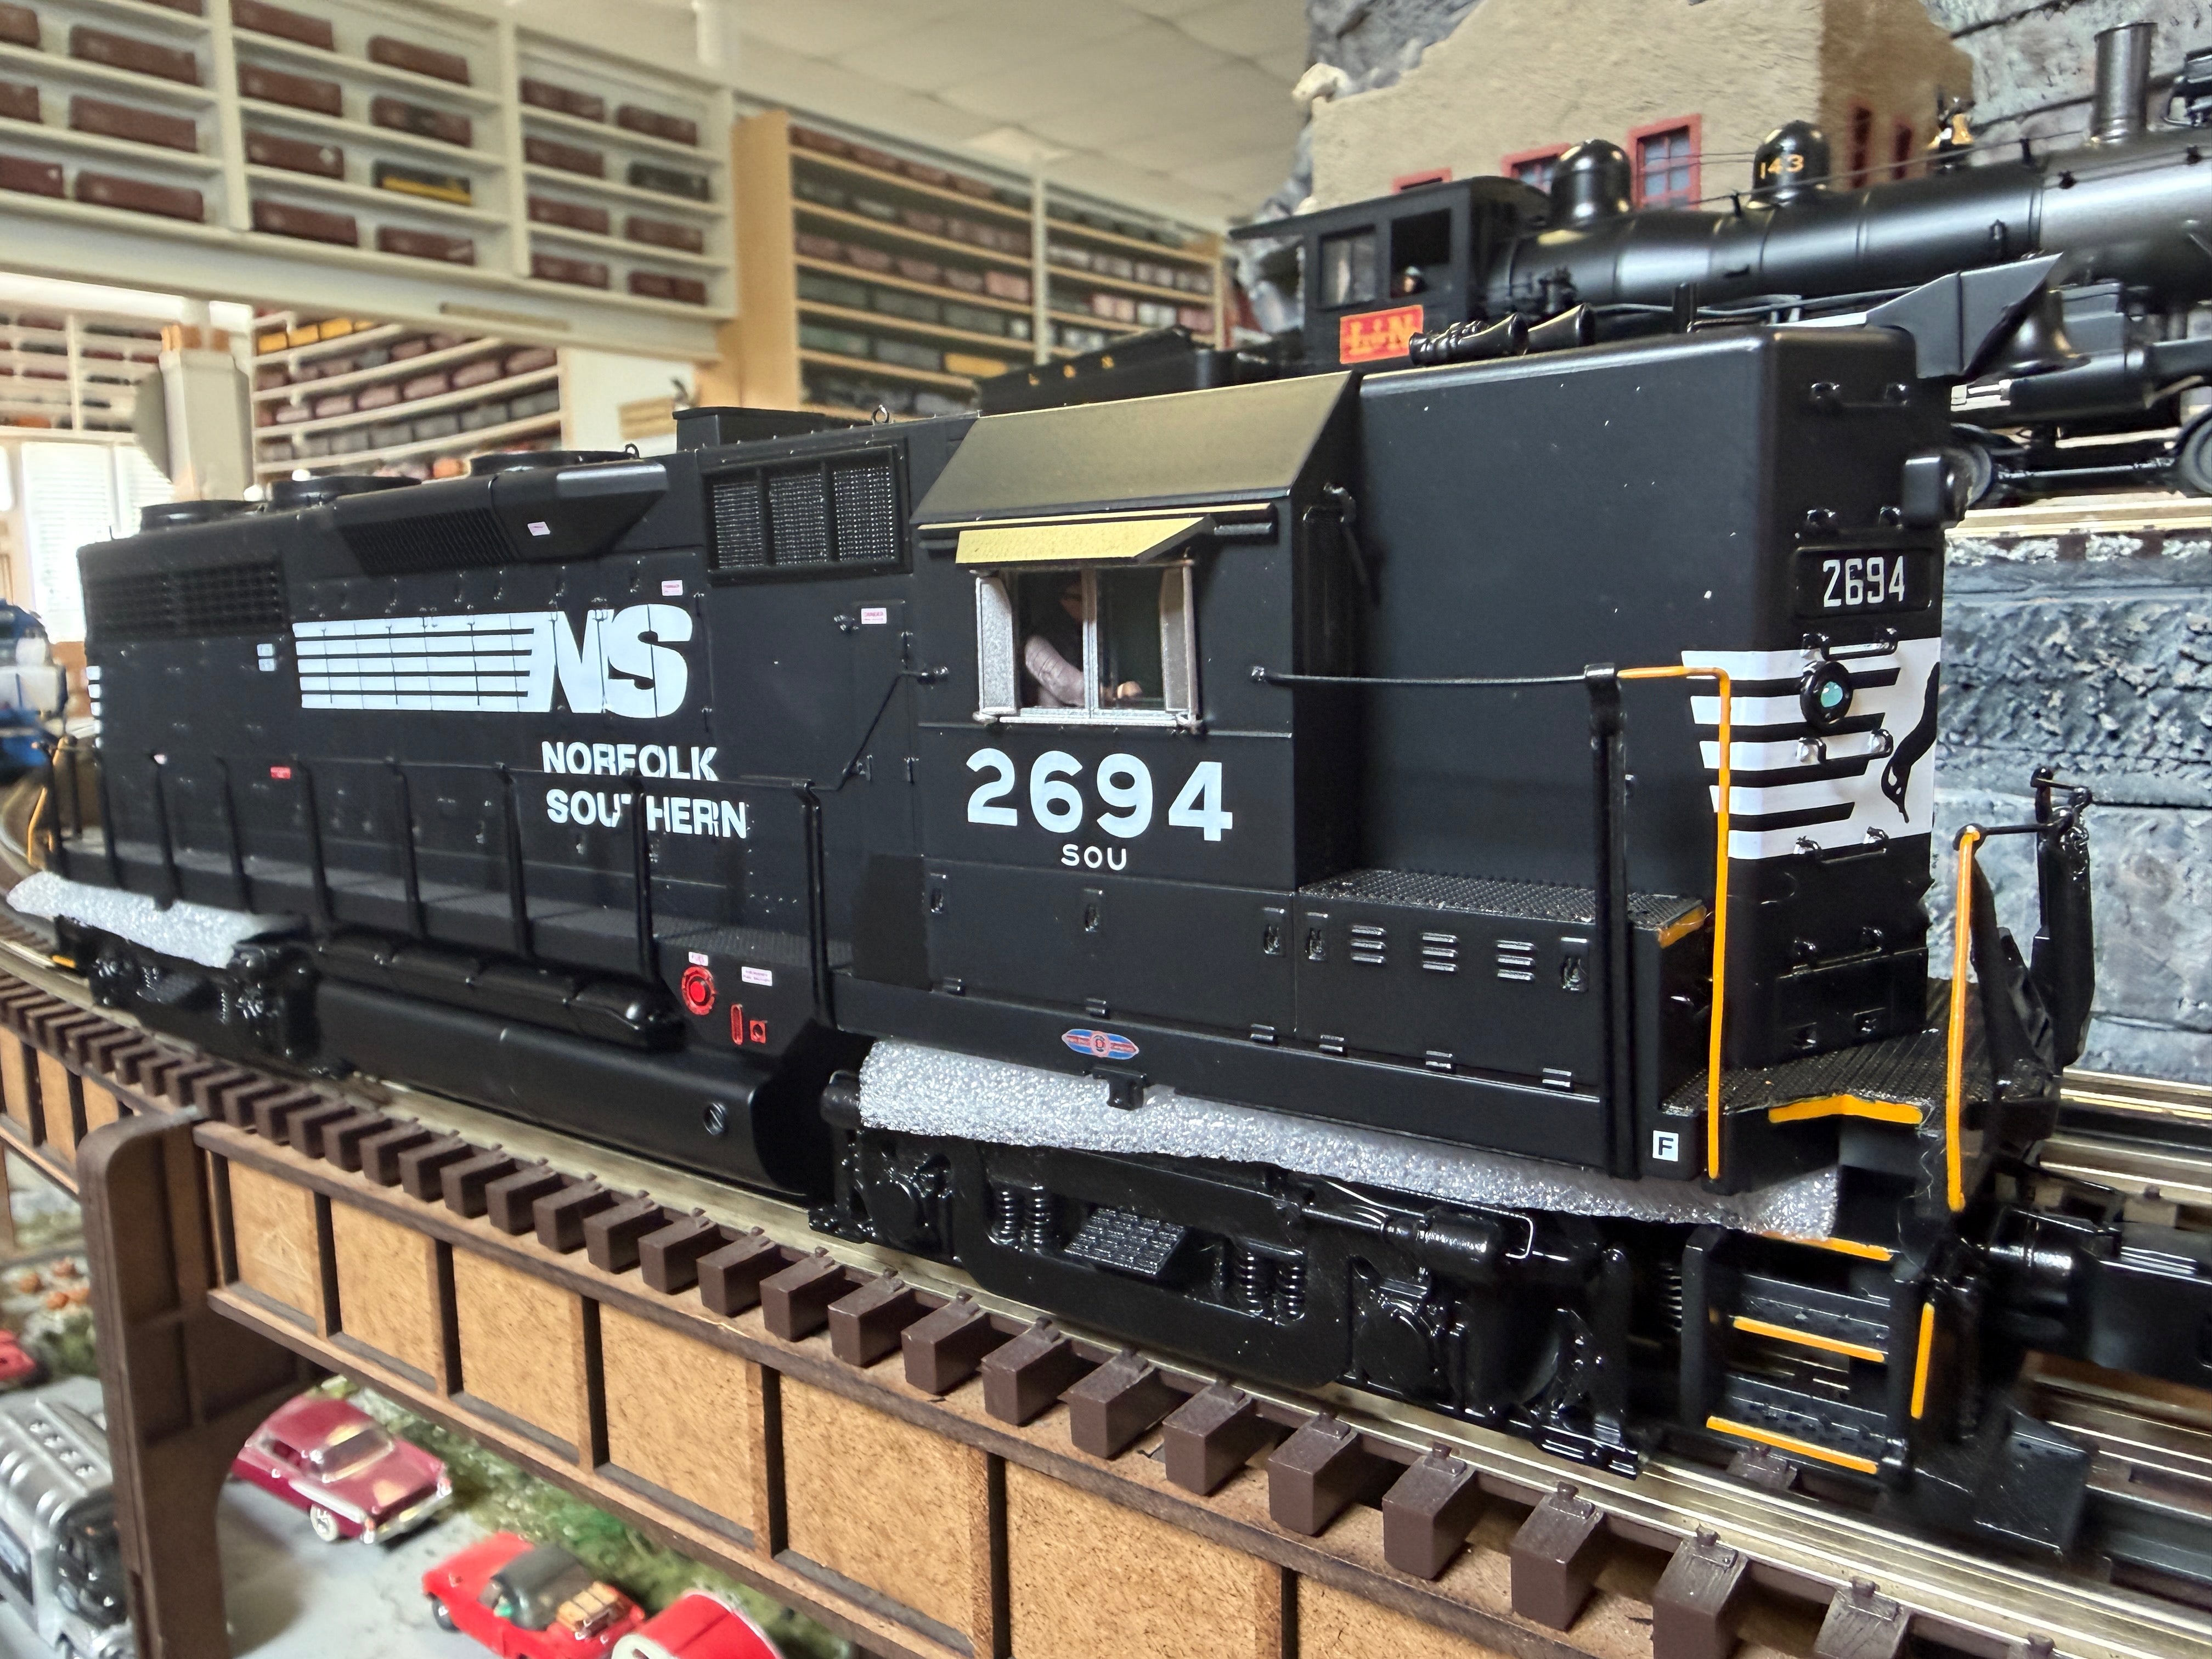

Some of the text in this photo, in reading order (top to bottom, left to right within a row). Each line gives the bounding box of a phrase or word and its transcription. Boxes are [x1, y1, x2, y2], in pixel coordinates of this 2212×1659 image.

[1760, 154, 1804, 179] 143
[1822, 555, 1905, 607] 2694
[522, 603, 692, 719] NS
[541, 741, 720, 782] NORFOLK
[966, 747, 1233, 842] 2694
[1060, 844, 1127, 871] SOU
[1658, 1136, 1674, 1155] F
